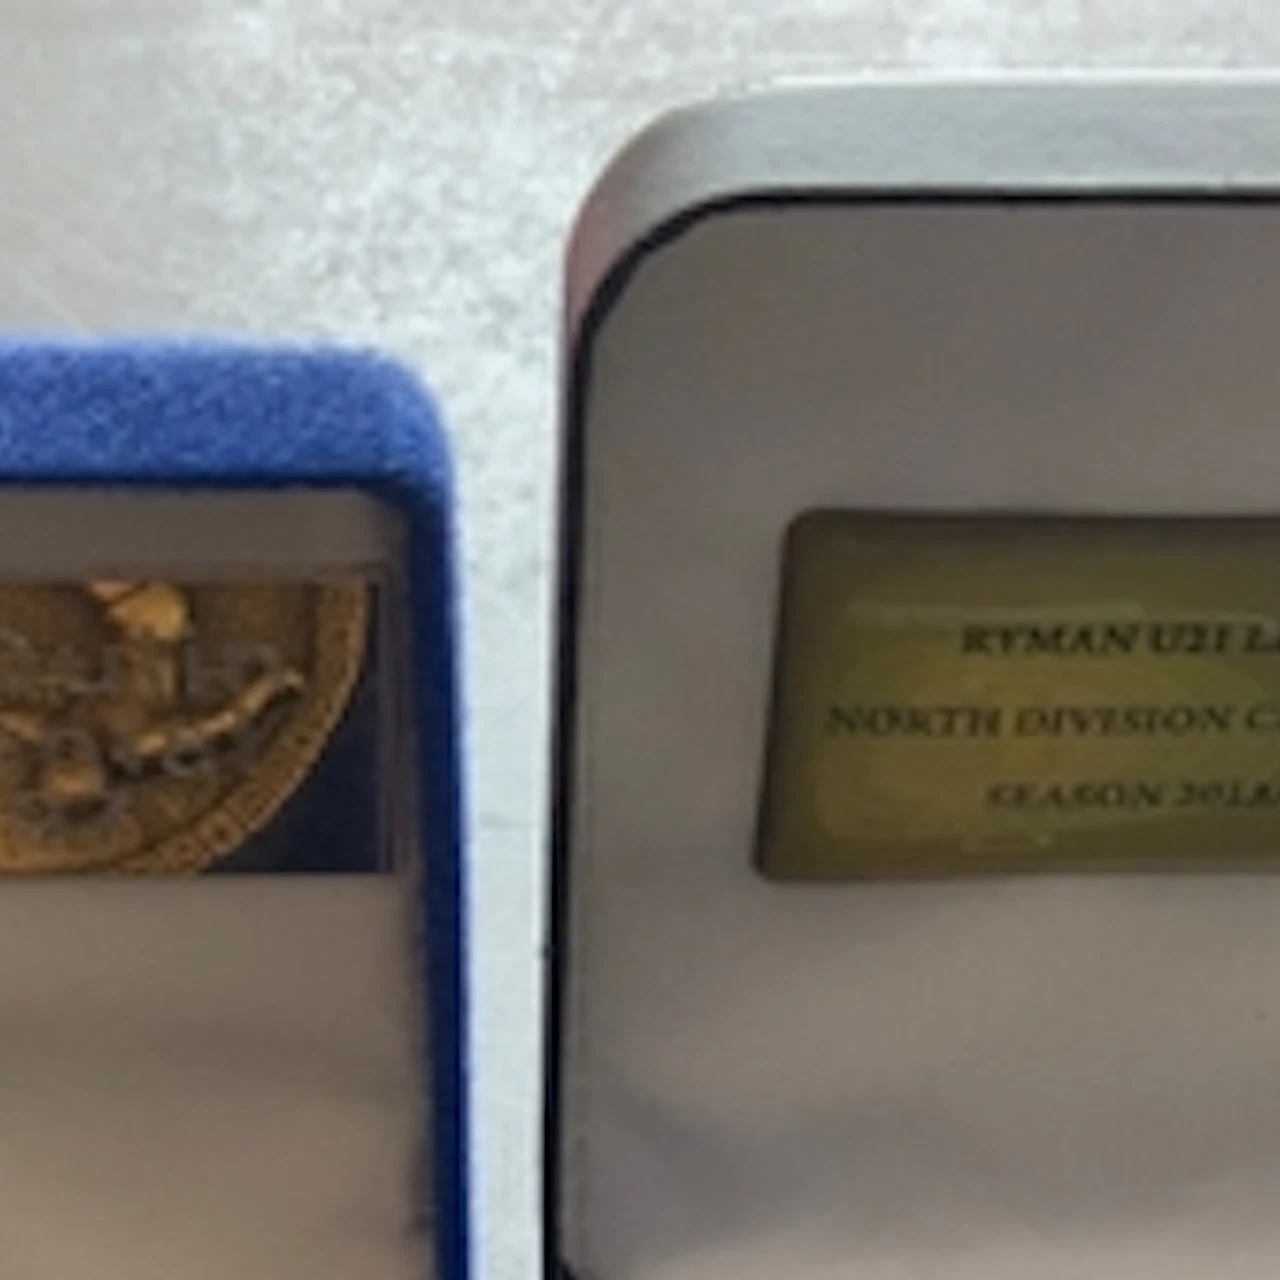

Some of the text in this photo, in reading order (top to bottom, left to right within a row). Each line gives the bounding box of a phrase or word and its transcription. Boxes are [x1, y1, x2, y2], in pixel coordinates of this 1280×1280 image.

[958, 619, 1140, 655] RYMAN
[824, 702, 1004, 739] NORTH
[1013, 702, 1234, 737] DIVISION
[985, 780, 1164, 812] SEASON
